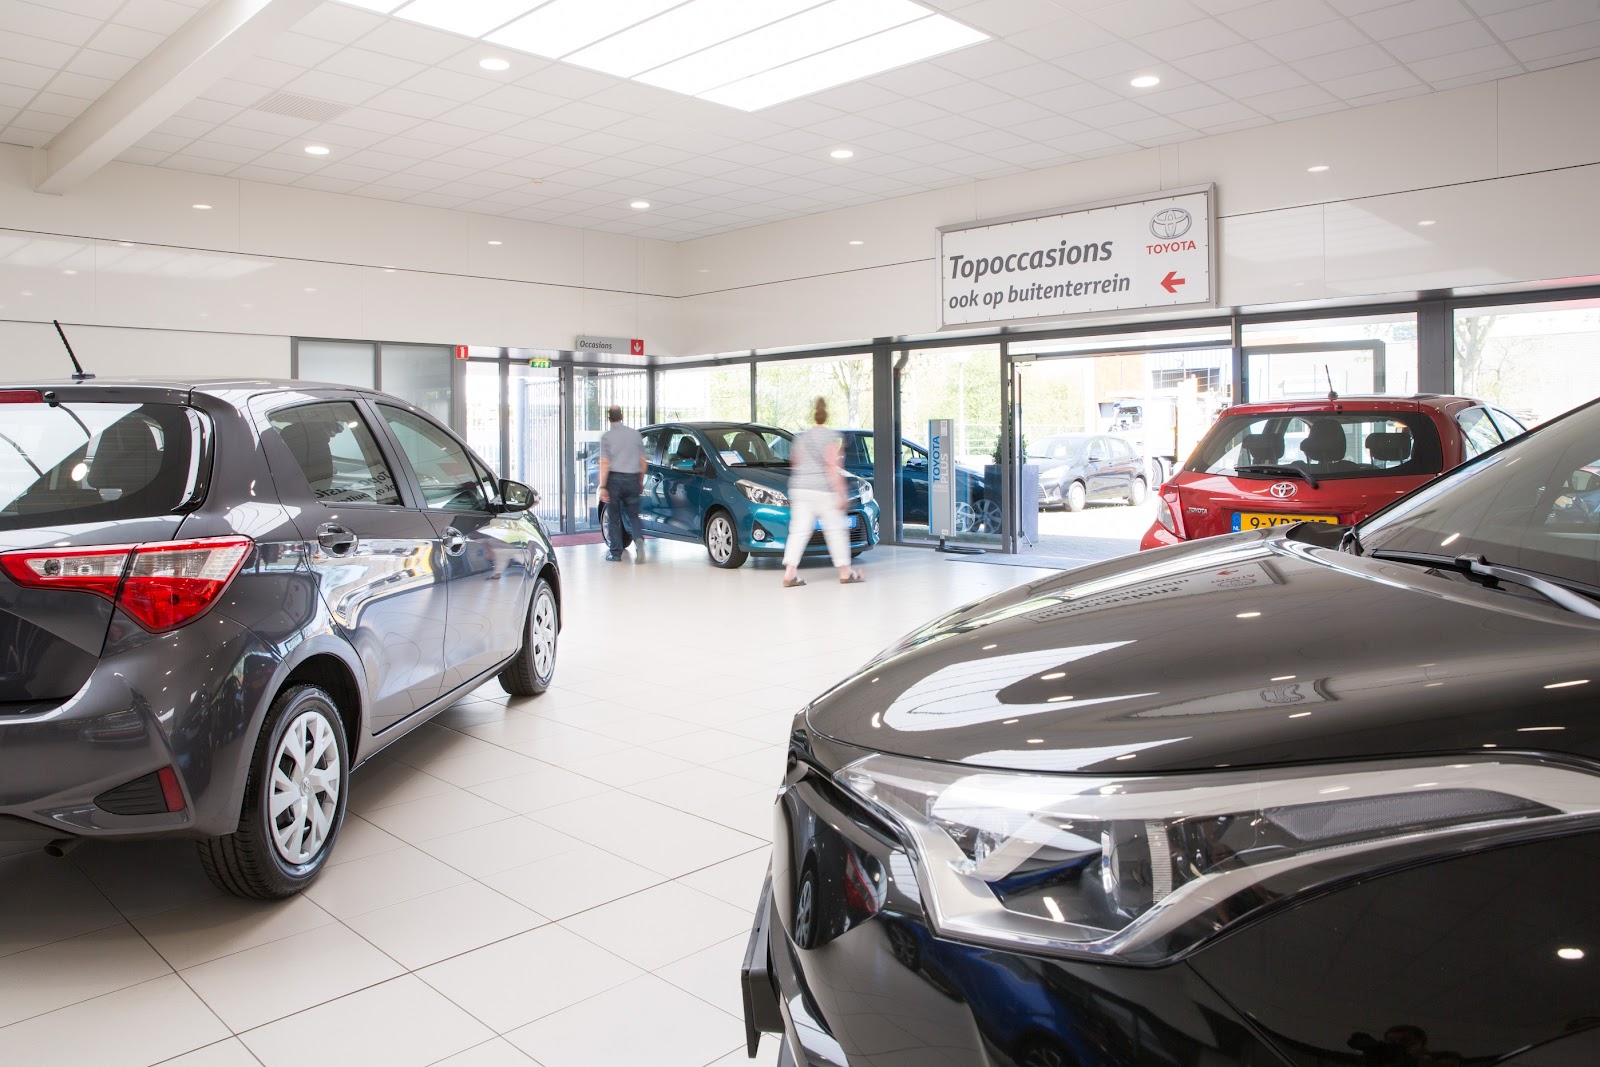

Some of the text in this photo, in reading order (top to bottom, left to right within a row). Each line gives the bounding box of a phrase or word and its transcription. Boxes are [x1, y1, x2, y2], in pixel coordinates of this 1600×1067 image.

[950, 240, 1113, 283] Topoccasions
[1146, 240, 1196, 255] TOYOTA
[949, 273, 1130, 309] ook op buitenterrein
[580, 340, 612, 349] Occasions
[941, 453, 949, 484] PLUS
